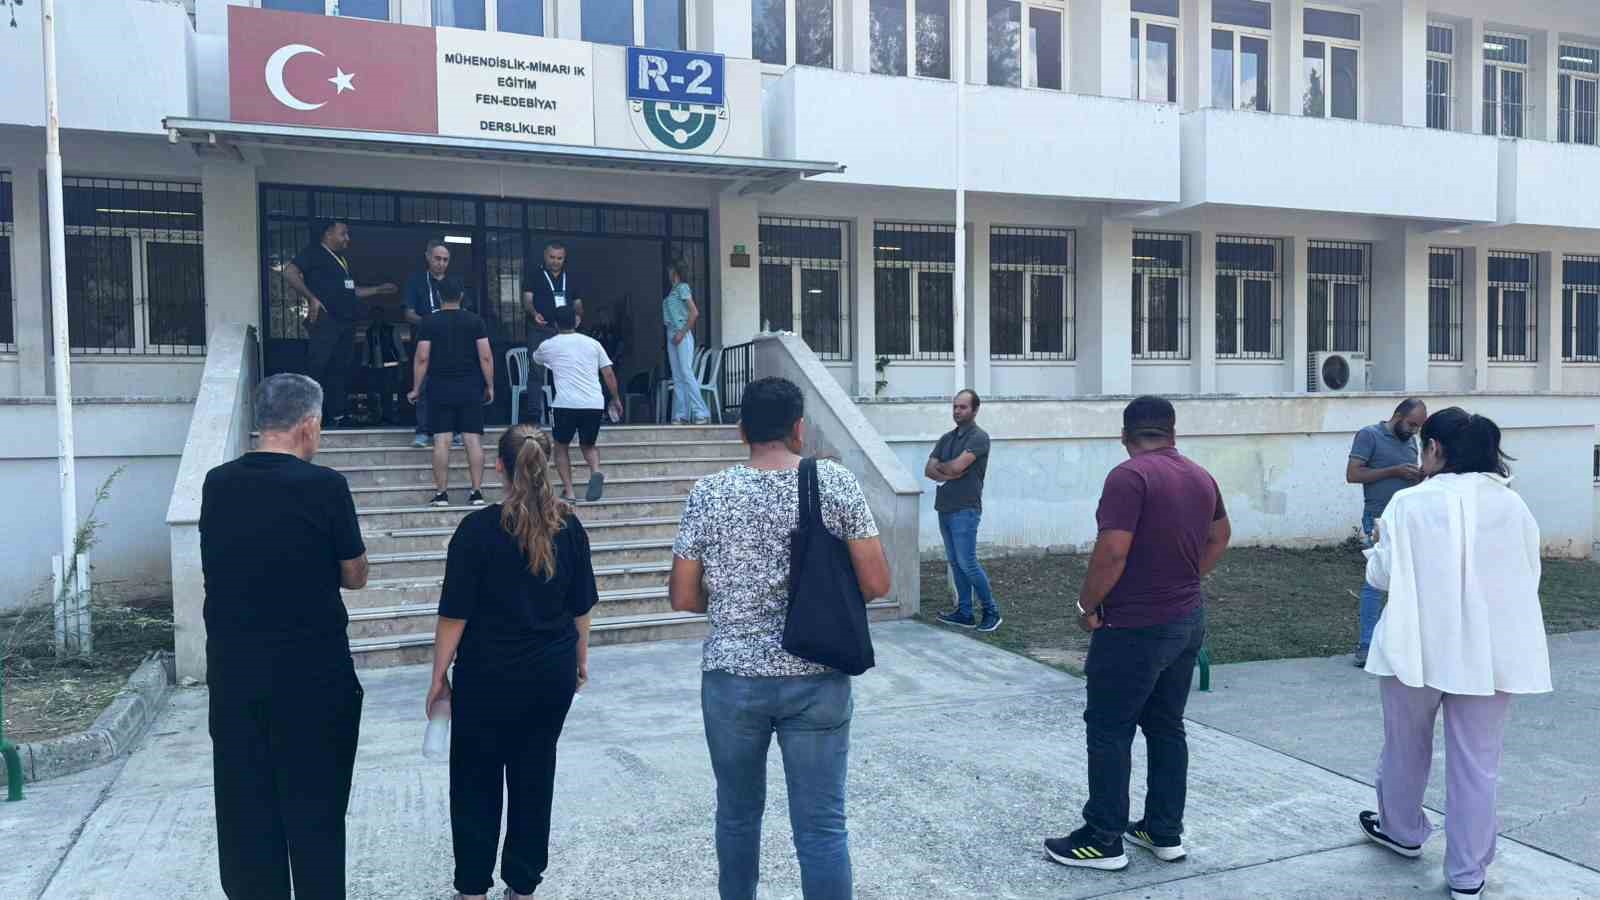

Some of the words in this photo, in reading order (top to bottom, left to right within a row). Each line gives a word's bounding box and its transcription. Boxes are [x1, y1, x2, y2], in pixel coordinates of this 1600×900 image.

[497, 76, 537, 89] EĞİTİM
[638, 54, 713, 95] R-2
[475, 93, 557, 111] FEN-EDEBİYAT
[479, 119, 556, 137] DERSLİKLERİ
